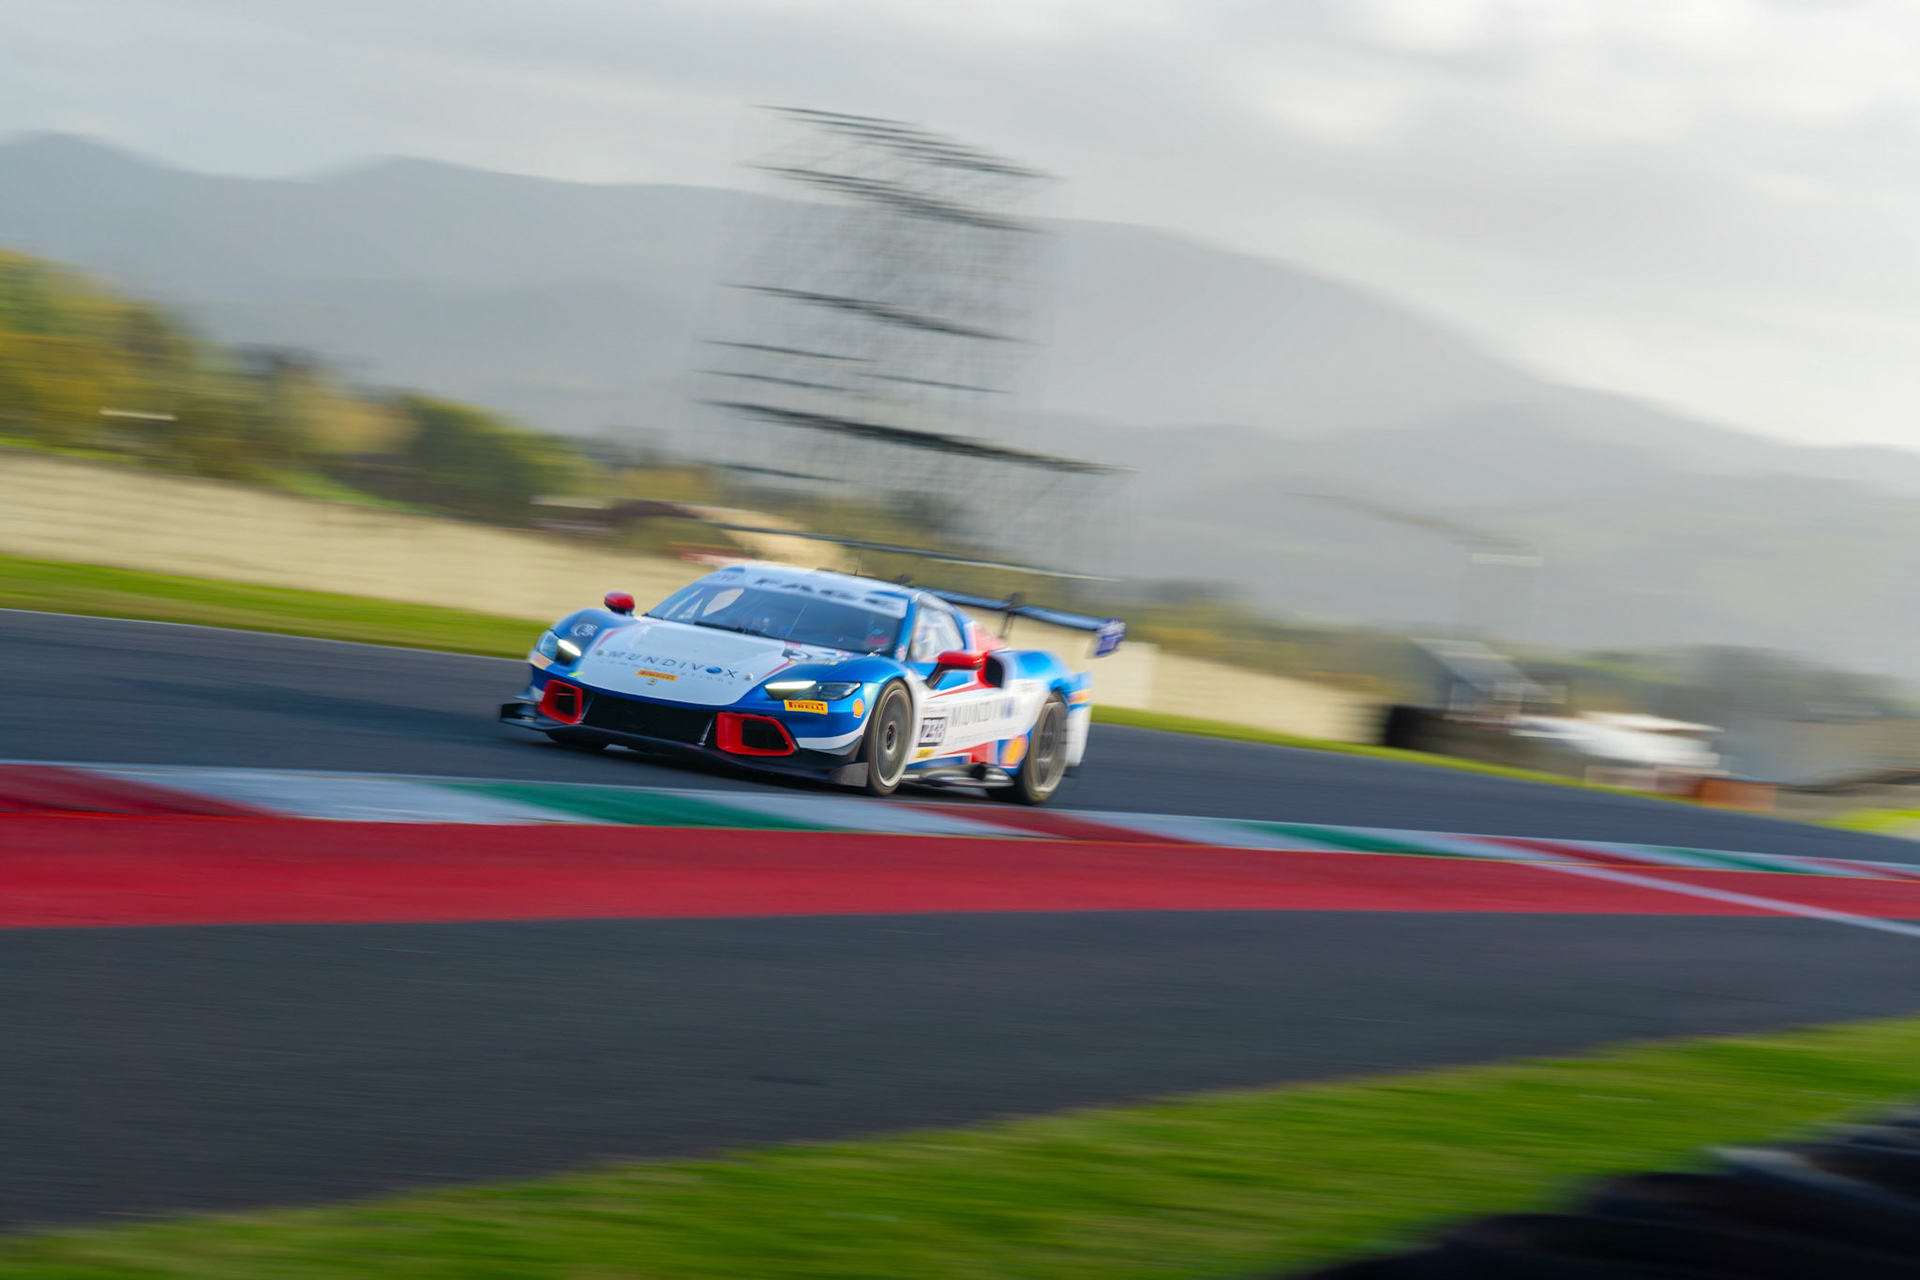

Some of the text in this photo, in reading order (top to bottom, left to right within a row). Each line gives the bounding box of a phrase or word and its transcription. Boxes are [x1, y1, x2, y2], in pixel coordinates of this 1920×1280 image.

[607, 651, 739, 678] MUNDIVOX
[788, 701, 824, 711] PIRELLI
[949, 696, 1021, 727] MUNDI
